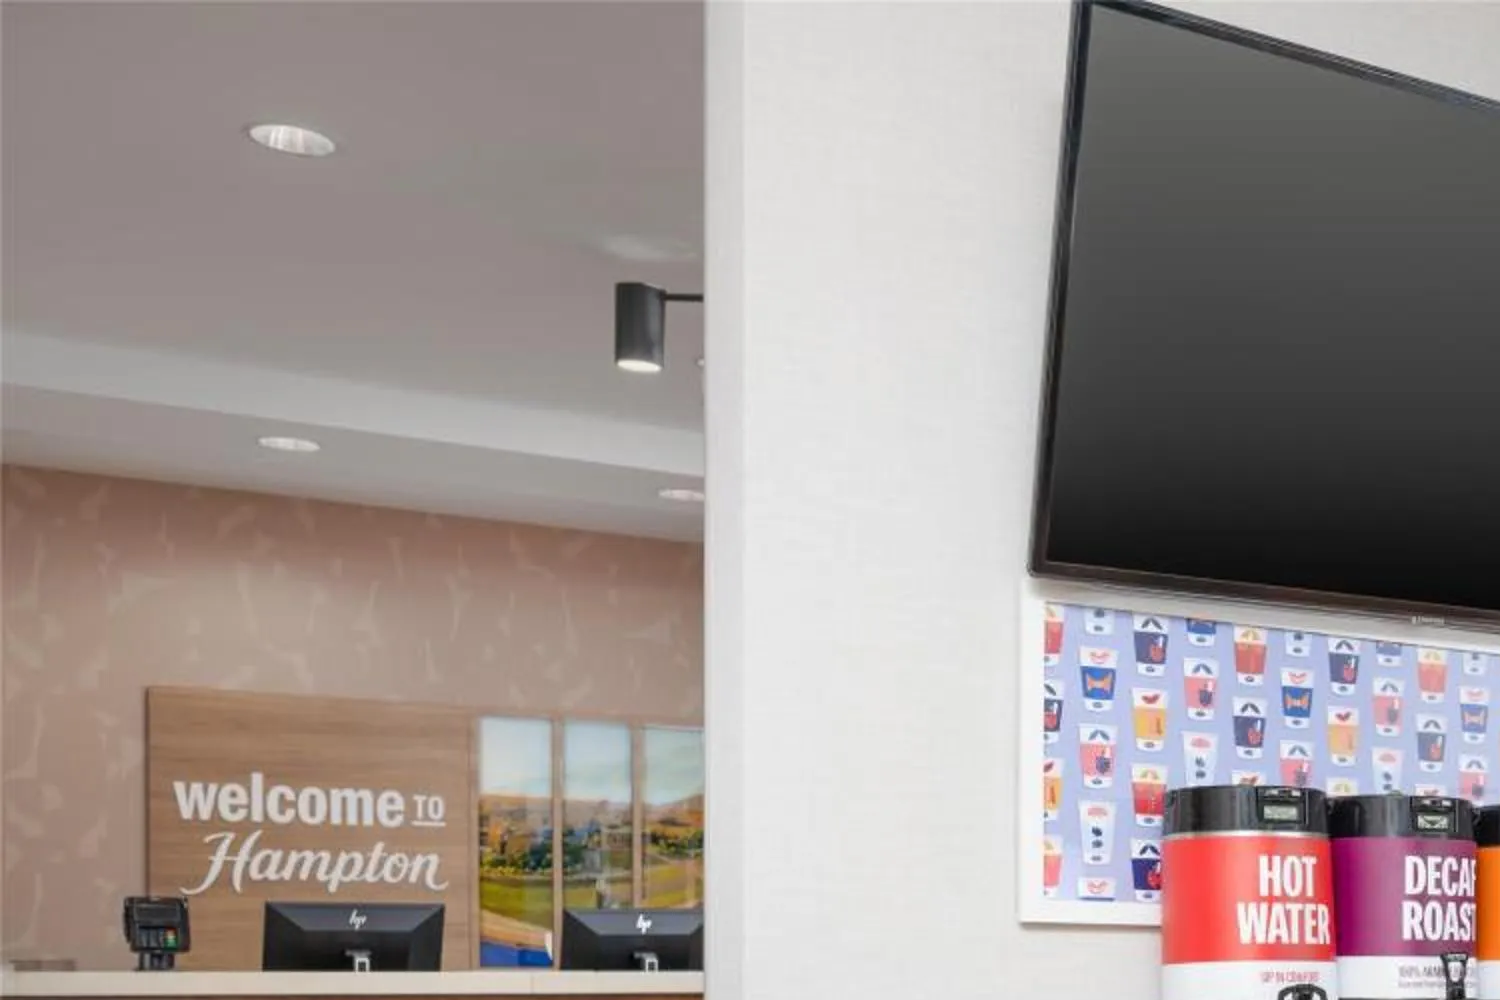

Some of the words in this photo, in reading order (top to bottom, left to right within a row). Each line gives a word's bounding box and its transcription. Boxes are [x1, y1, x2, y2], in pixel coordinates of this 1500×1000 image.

[173, 772, 405, 827] welcome
[412, 795, 445, 821] TO
[179, 829, 449, 895] Hampton
[1259, 855, 1317, 897] HOT
[1236, 902, 1330, 945] WATER
[1401, 901, 1477, 942] ROAST
